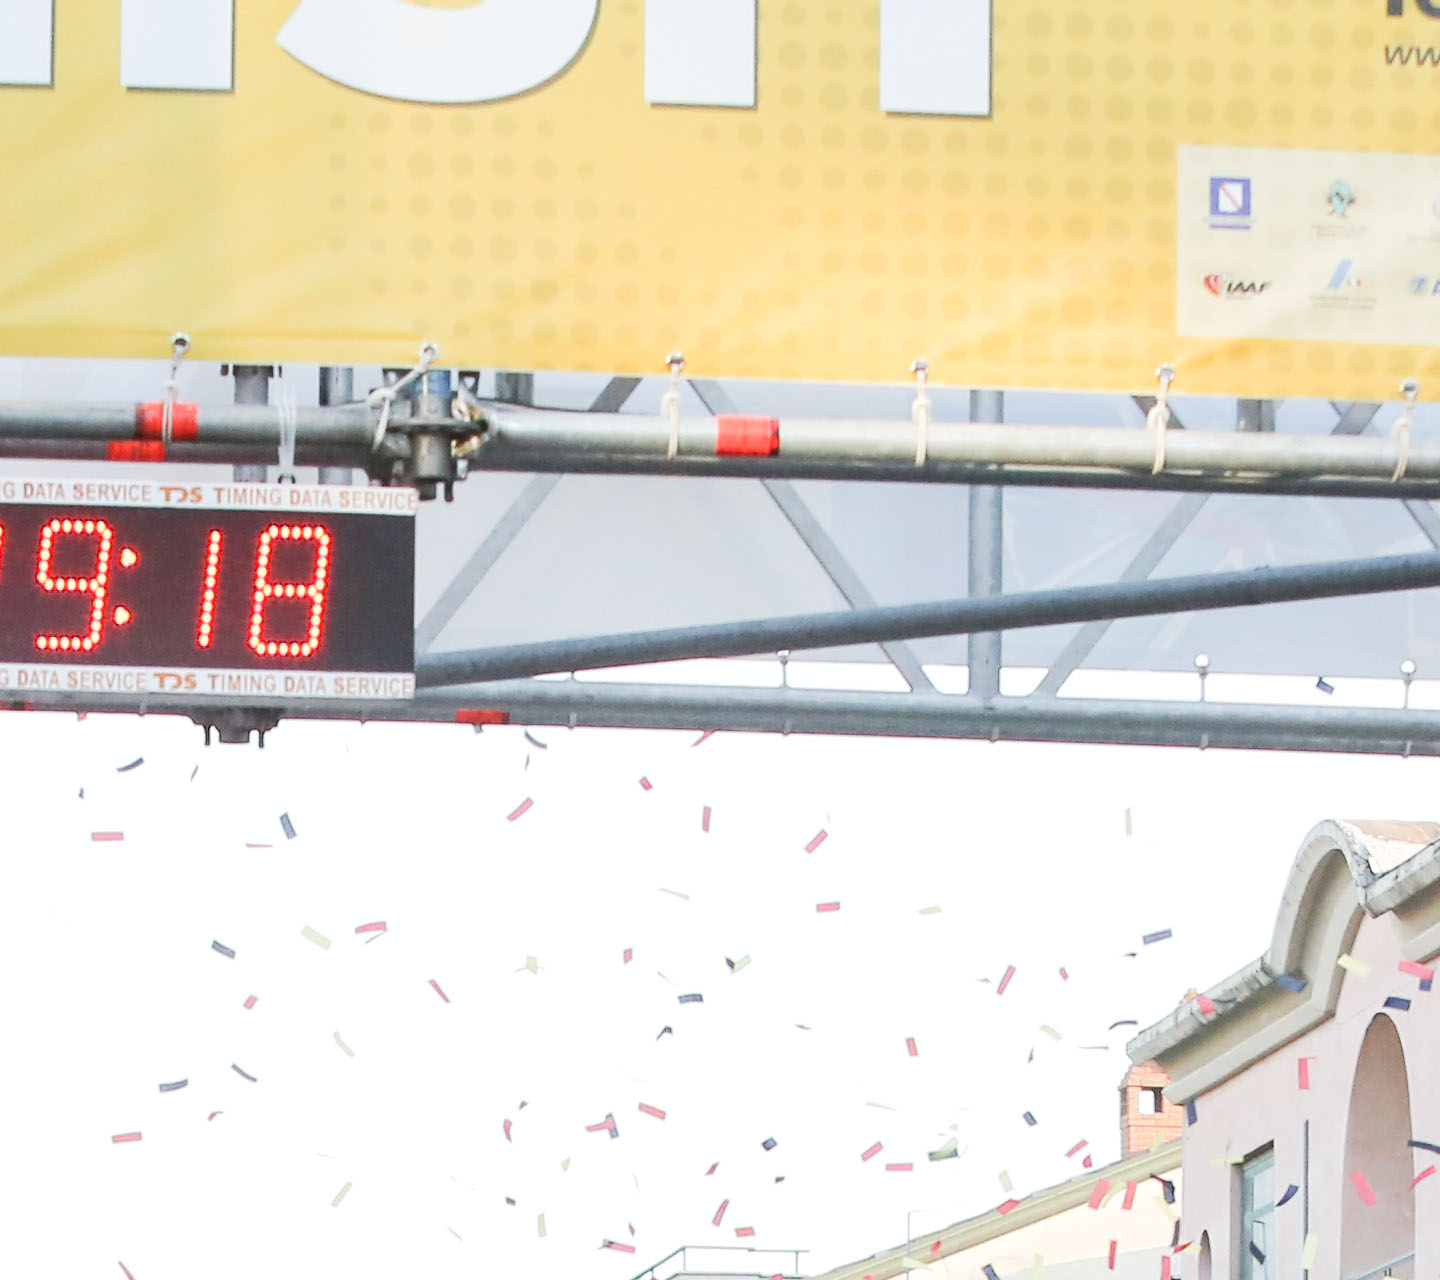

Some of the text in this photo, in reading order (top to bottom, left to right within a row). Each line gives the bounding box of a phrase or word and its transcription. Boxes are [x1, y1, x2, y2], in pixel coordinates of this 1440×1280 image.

[23, 481, 65, 501] DATA
[72, 483, 152, 503] SERVICE
[212, 486, 283, 506] TIMING
[290, 488, 332, 508] DATA
[338, 490, 418, 511] SERVICE
[18, 669, 60, 689] DATA
[67, 670, 146, 691] SERVICE
[207, 673, 278, 693] TIMING
[284, 675, 327, 695] DATA
[333, 676, 414, 698] SERVICE
